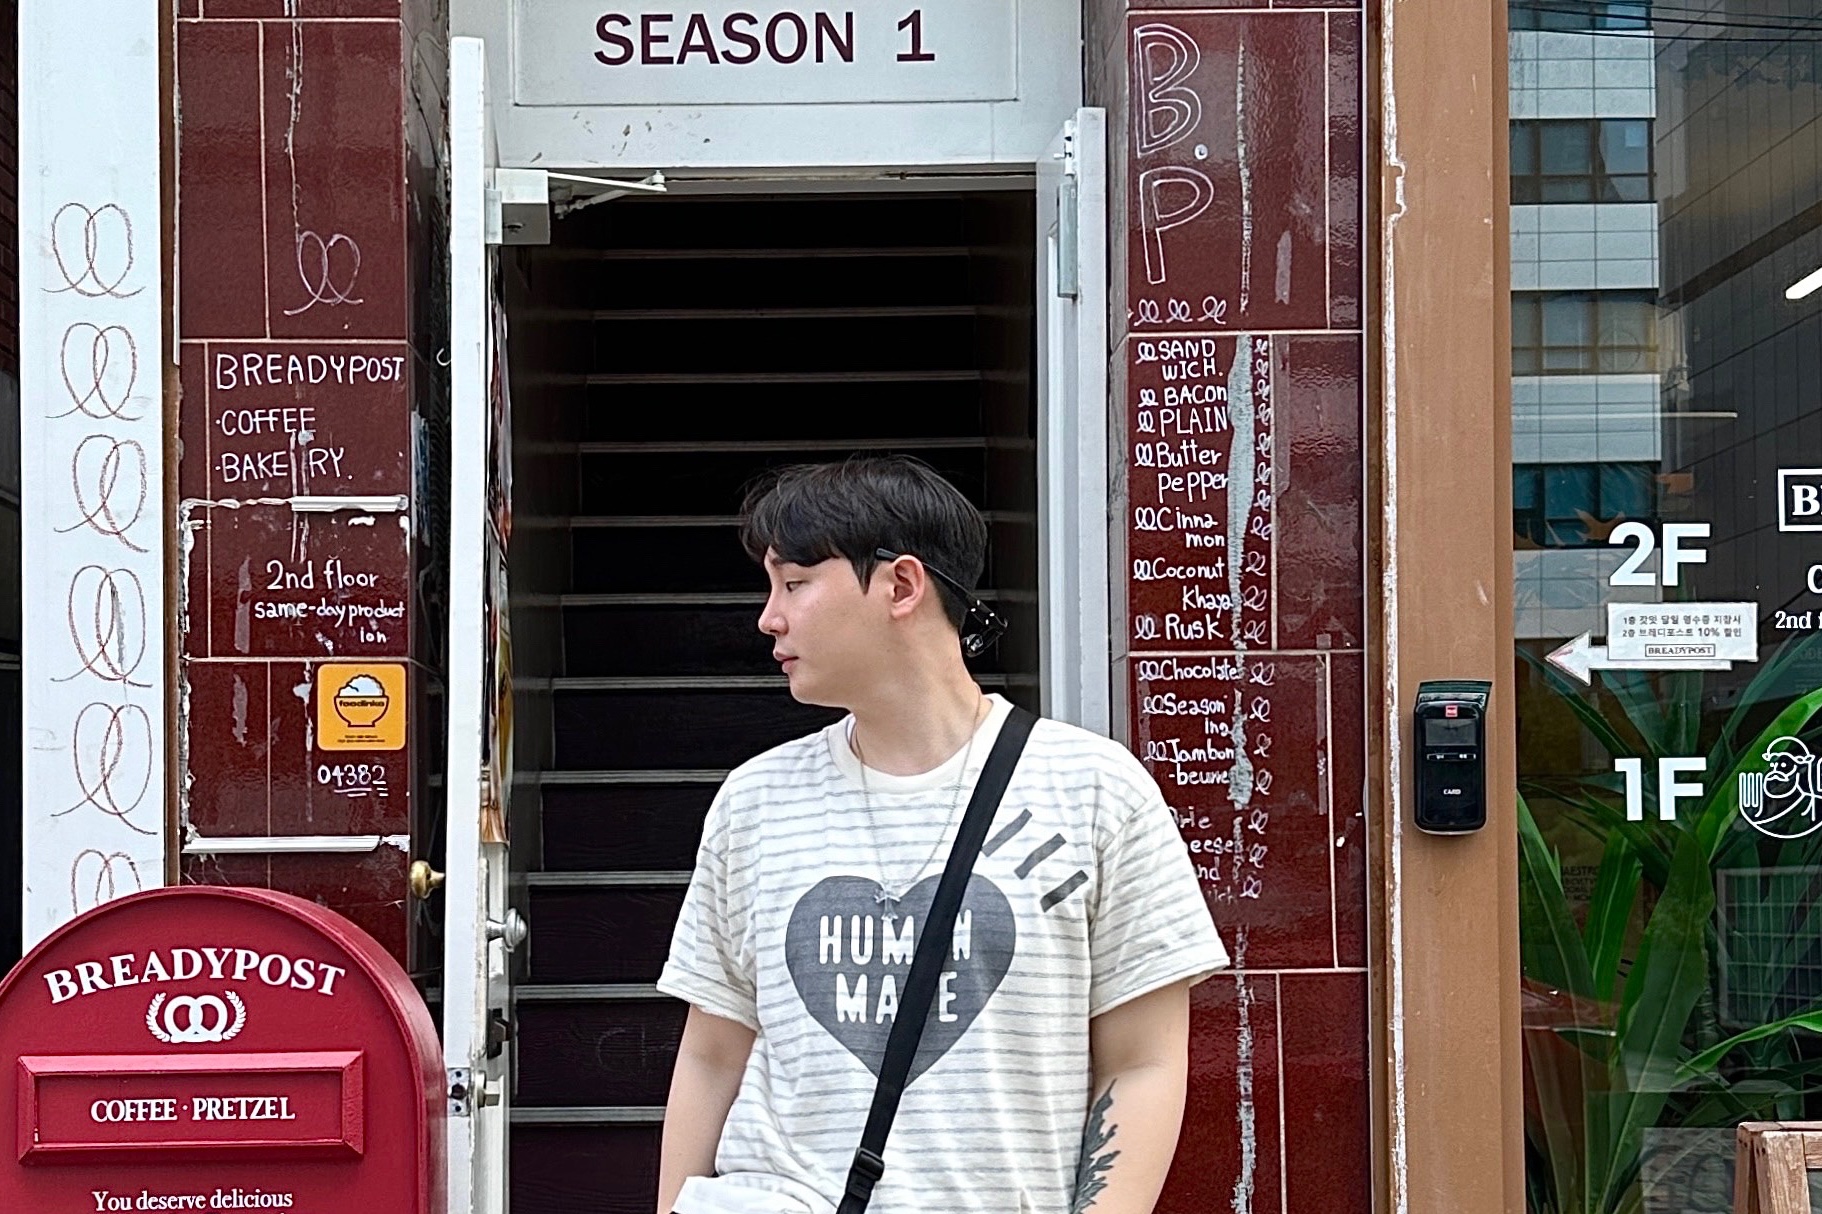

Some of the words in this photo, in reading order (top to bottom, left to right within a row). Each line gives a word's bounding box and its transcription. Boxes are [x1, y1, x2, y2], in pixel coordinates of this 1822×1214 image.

[594, 11, 854, 65] SEASON
[897, 10, 936, 62] 1
[1158, 340, 1216, 360] SAND
[216, 353, 404, 390] BREADYPOST
[1160, 406, 1228, 438] PLAIN
[1156, 439, 1222, 468] Butter
[1157, 506, 1218, 532] Cinna
[1185, 532, 1225, 548] mon
[1608, 521, 1711, 587] 2F
[266, 559, 315, 590] 2nd
[323, 559, 379, 590] floor
[1152, 557, 1225, 579] Coconut
[254, 597, 346, 628] same-day
[349, 599, 405, 627] product
[1775, 611, 1812, 629] 2nd
[1165, 613, 1224, 640] Rusk
[1698, 627, 1720, 637] 10%
[1647, 646, 1713, 655] BREADYPOST
[1160, 656, 1241, 681] Chocolate
[317, 764, 386, 788] 04382
[1614, 757, 1707, 822] 1F
[819, 910, 972, 965] HUMN
[43, 947, 346, 1005] BREADYPOST
[835, 971, 959, 1024] MAE
[90, 1098, 178, 1123] COFFEE
[192, 1097, 296, 1121] PRETZEL
[92, 1191, 132, 1211] You
[136, 1190, 206, 1210] deserve
[210, 1188, 293, 1209] delicious
